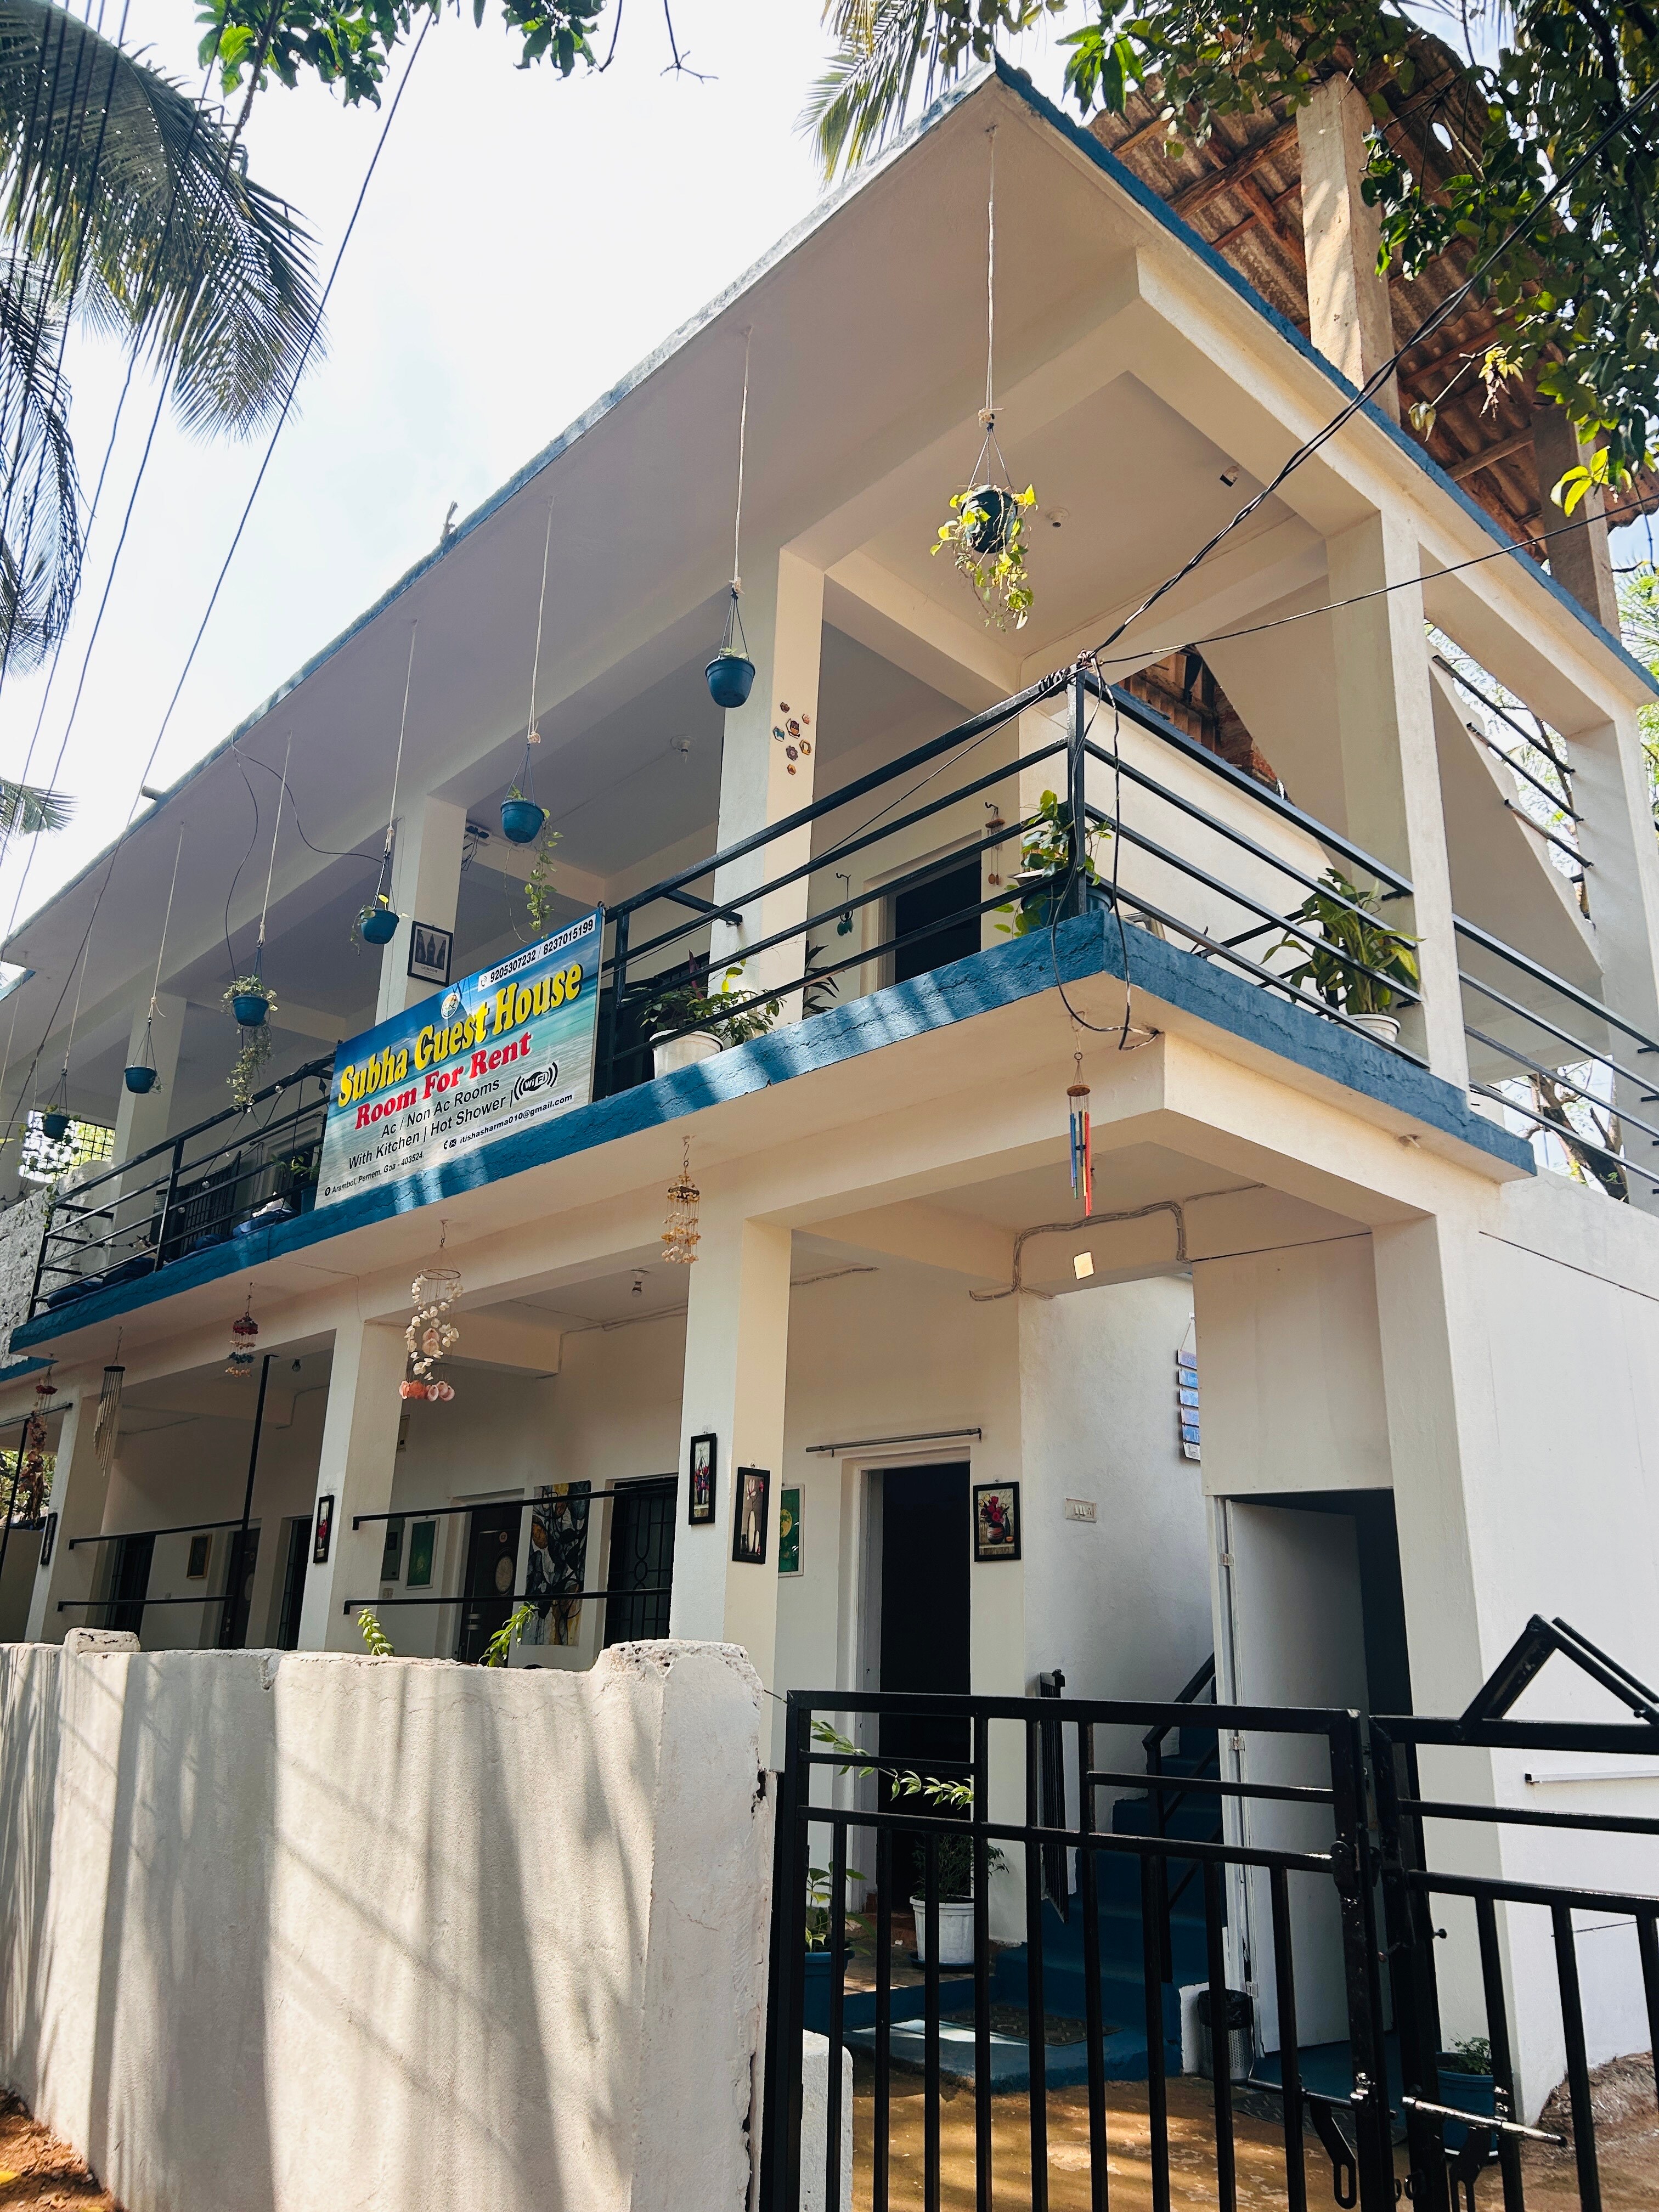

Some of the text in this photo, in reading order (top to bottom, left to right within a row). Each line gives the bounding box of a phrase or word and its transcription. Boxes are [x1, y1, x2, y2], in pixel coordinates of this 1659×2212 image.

[490, 949, 536, 983] 9205307232
[543, 919, 594, 955] 8237015199
[338, 963, 583, 1107] Subha Guest House
[354, 1031, 533, 1130] Room For Rent
[381, 1123, 397, 1138] Ac
[407, 1108, 430, 1127] Non
[433, 1100, 450, 1116] Ac
[454, 1079, 500, 1107] Rooms
[348, 1150, 373, 1170] With
[376, 1132, 420, 1159] Kitchen
[430, 1116, 453, 1137] Hot
[455, 1095, 506, 1126] Shower
[383, 1163, 396, 1173] Goa
